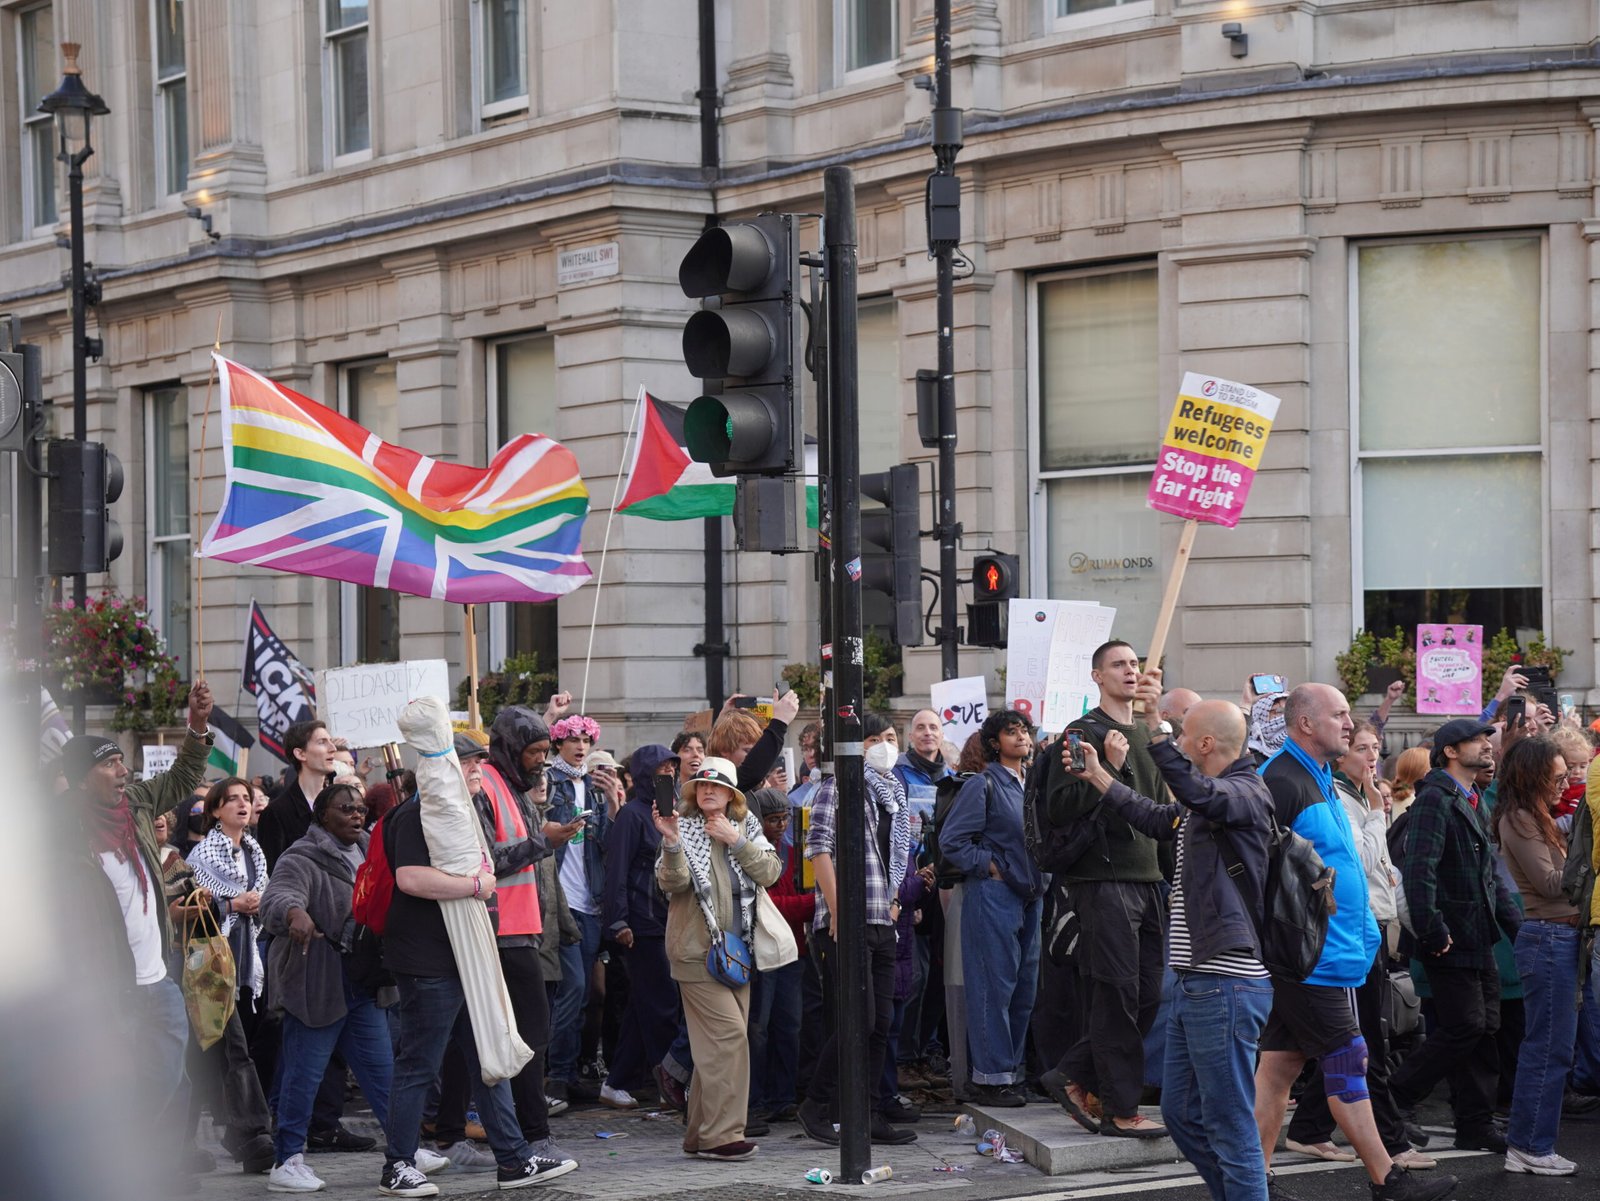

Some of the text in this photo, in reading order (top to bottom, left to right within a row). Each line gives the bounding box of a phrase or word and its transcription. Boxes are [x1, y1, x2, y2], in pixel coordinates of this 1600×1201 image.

[560, 247, 613, 269] WHITEHALL SW1
[1218, 391, 1258, 409] TO RACISM
[1220, 383, 1257, 399] STAND UP
[1179, 400, 1265, 440] Refugees
[1174, 426, 1253, 459] welcome
[1162, 451, 1242, 487] Stop the
[1155, 474, 1235, 509] far right
